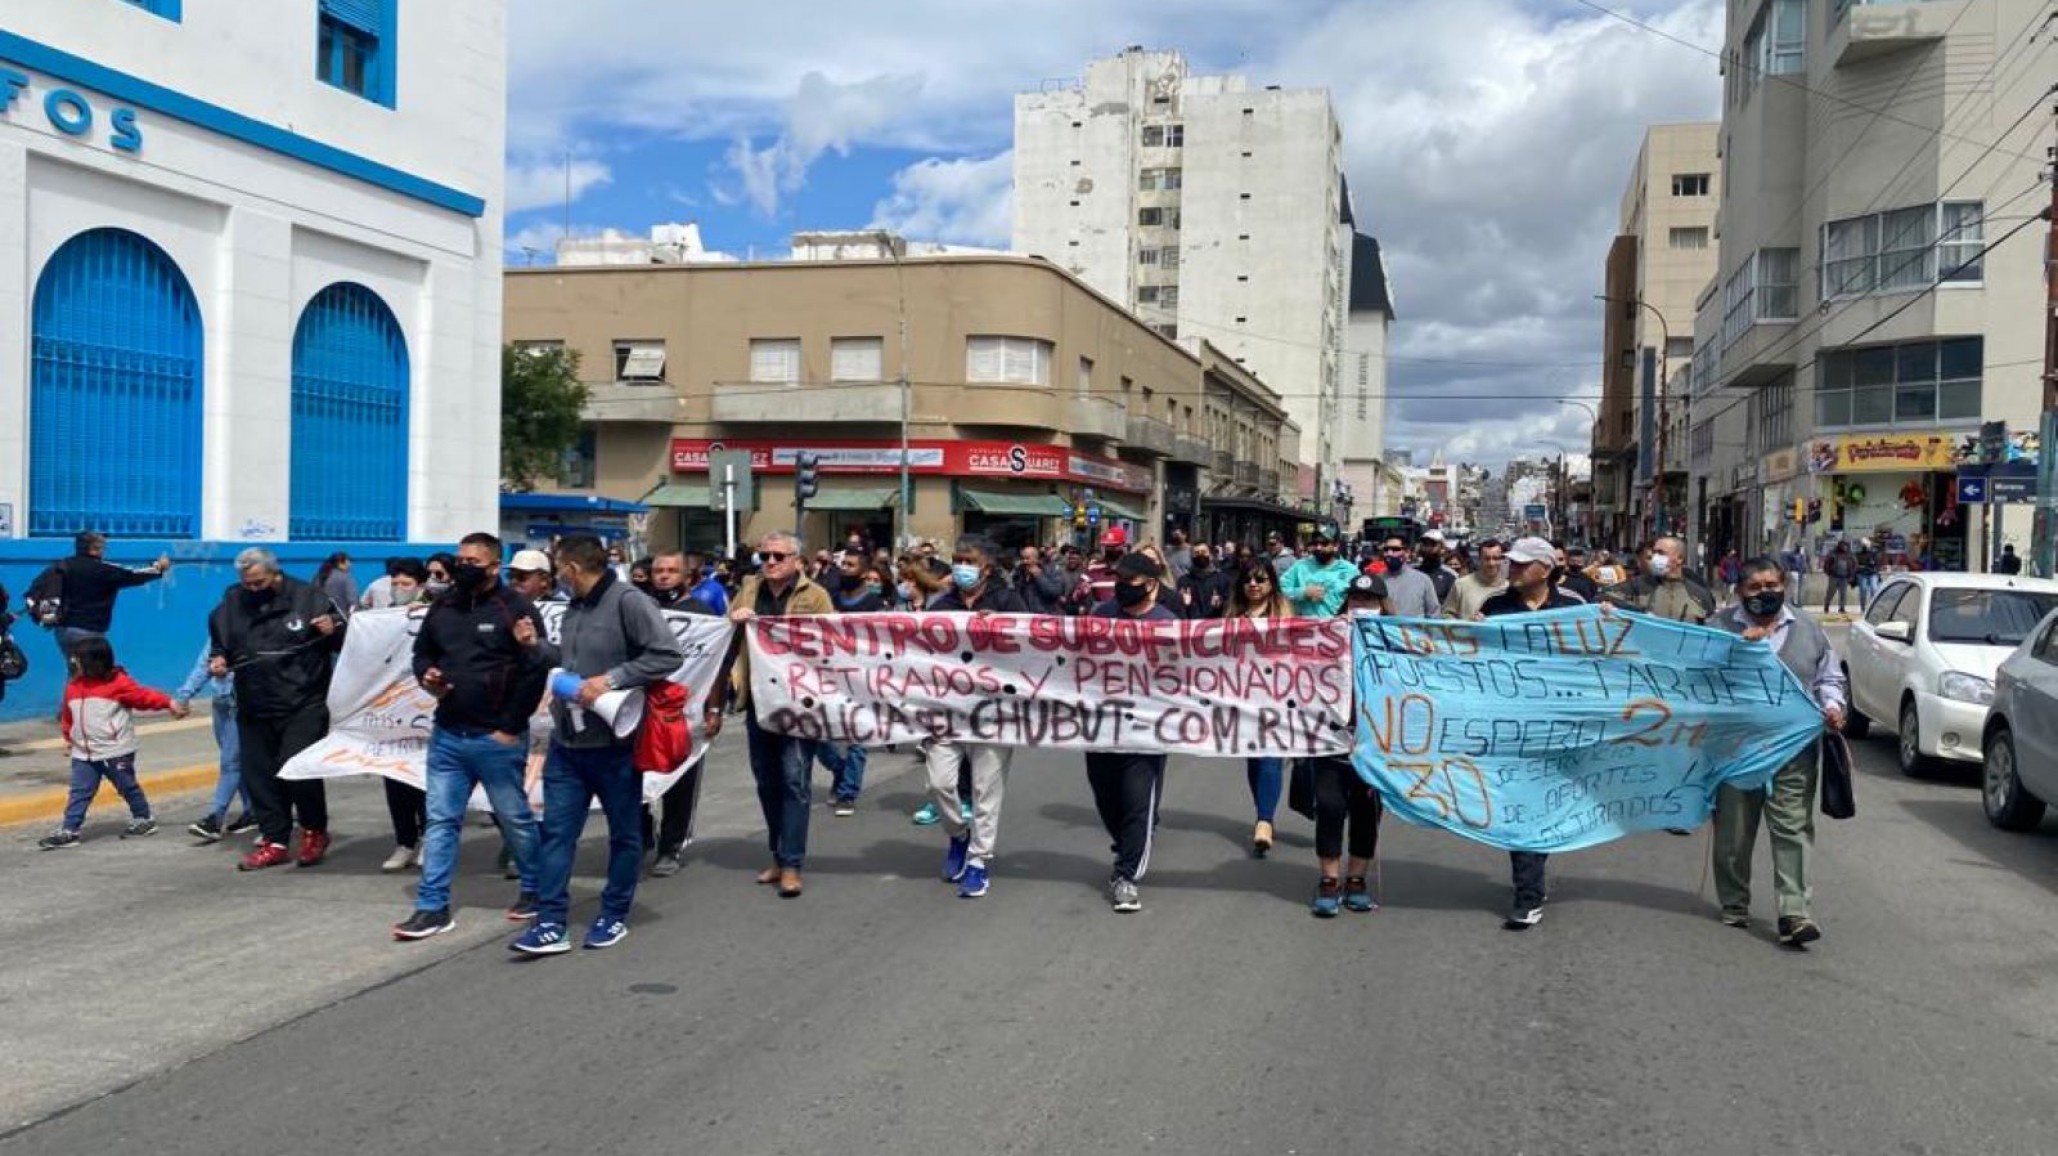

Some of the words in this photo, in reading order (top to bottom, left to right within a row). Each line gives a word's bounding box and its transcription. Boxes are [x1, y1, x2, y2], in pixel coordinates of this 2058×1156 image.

[674, 452, 708, 462] CASA
[969, 453, 1007, 466] CASA
[1009, 446, 1060, 474] SUAREZ
[758, 614, 959, 657] CENTRO
[966, 615, 1021, 655] DE
[1028, 614, 1349, 668] SUBOFICIALES
[787, 662, 999, 702] RETIRADOS
[1020, 665, 1053, 700] Y
[1075, 656, 1342, 704] PENSIONADOS
[769, 700, 908, 742] POLICIA
[1387, 755, 1492, 830] 30
